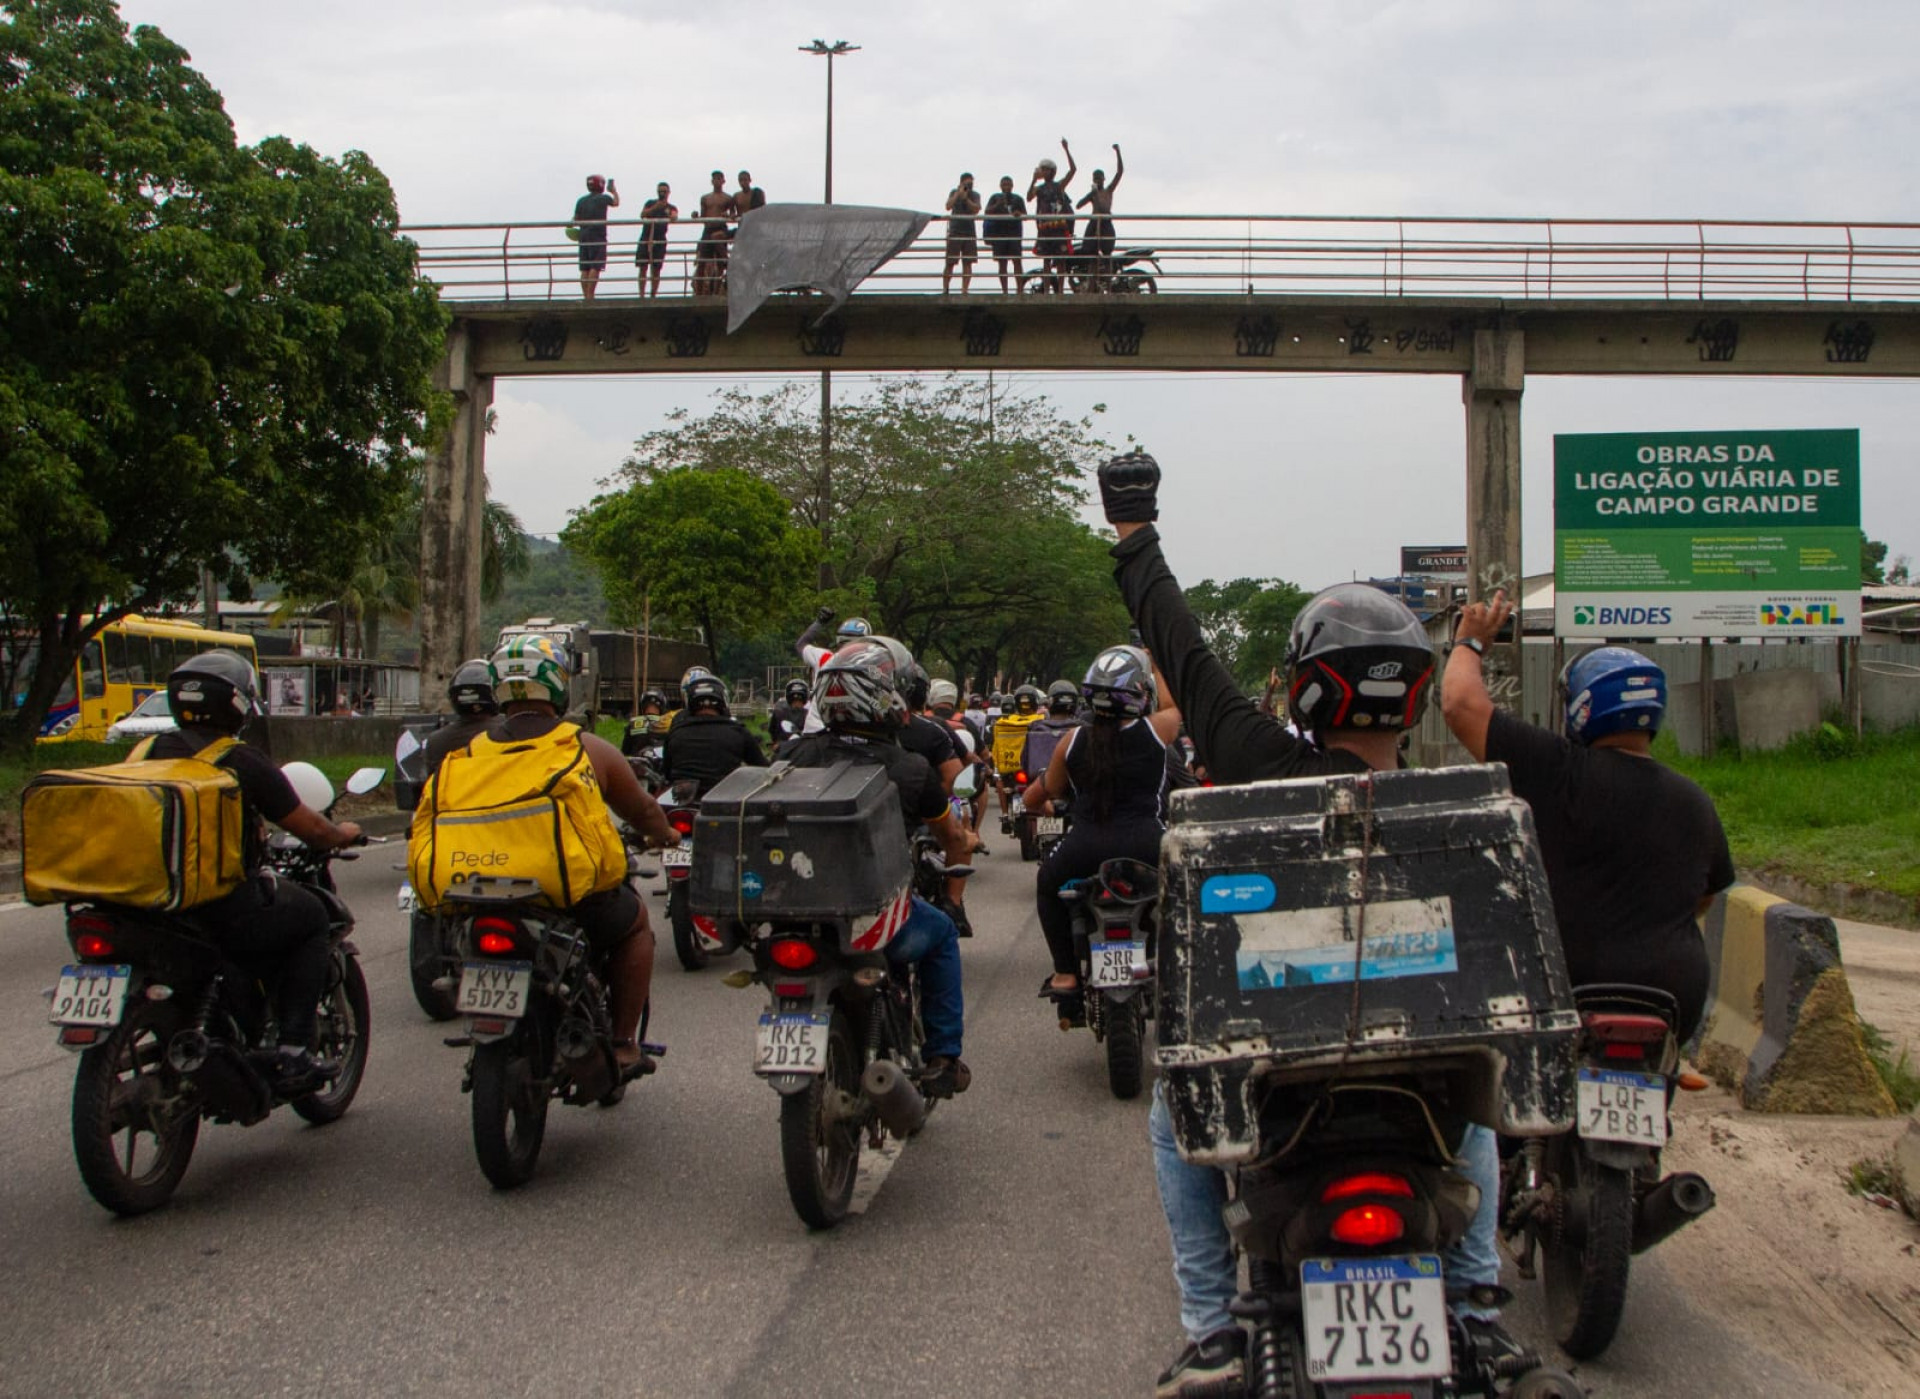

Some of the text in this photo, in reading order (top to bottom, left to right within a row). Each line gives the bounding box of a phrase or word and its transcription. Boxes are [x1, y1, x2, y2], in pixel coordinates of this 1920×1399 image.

[1637, 445, 1775, 464] OBRAS DA
[1575, 465, 1840, 494] LIGAÇÃO VIÁRIA DE
[1596, 495, 1818, 515] CAMPO GRANDE
[1418, 557, 1460, 566] GRANDE
[1599, 606, 1672, 625] BNDES
[1761, 604, 1845, 625] BRASIL
[451, 848, 510, 868] Pede
[1104, 950, 1133, 966] SRR
[1099, 967, 1132, 982] 4J5
[75, 977, 112, 997] TTJ
[60, 997, 112, 1019] 9A04
[467, 988, 518, 1010] 5D73
[771, 1025, 811, 1045] RKE
[762, 1046, 817, 1066] 2D12
[1598, 1084, 1645, 1110] LQF
[1590, 1108, 1655, 1137] 7B81
[1345, 1266, 1398, 1280] BRASIL
[1335, 1281, 1413, 1322] RKC
[1324, 1324, 1430, 1367] 7I36
[1311, 1360, 1327, 1375] BR
